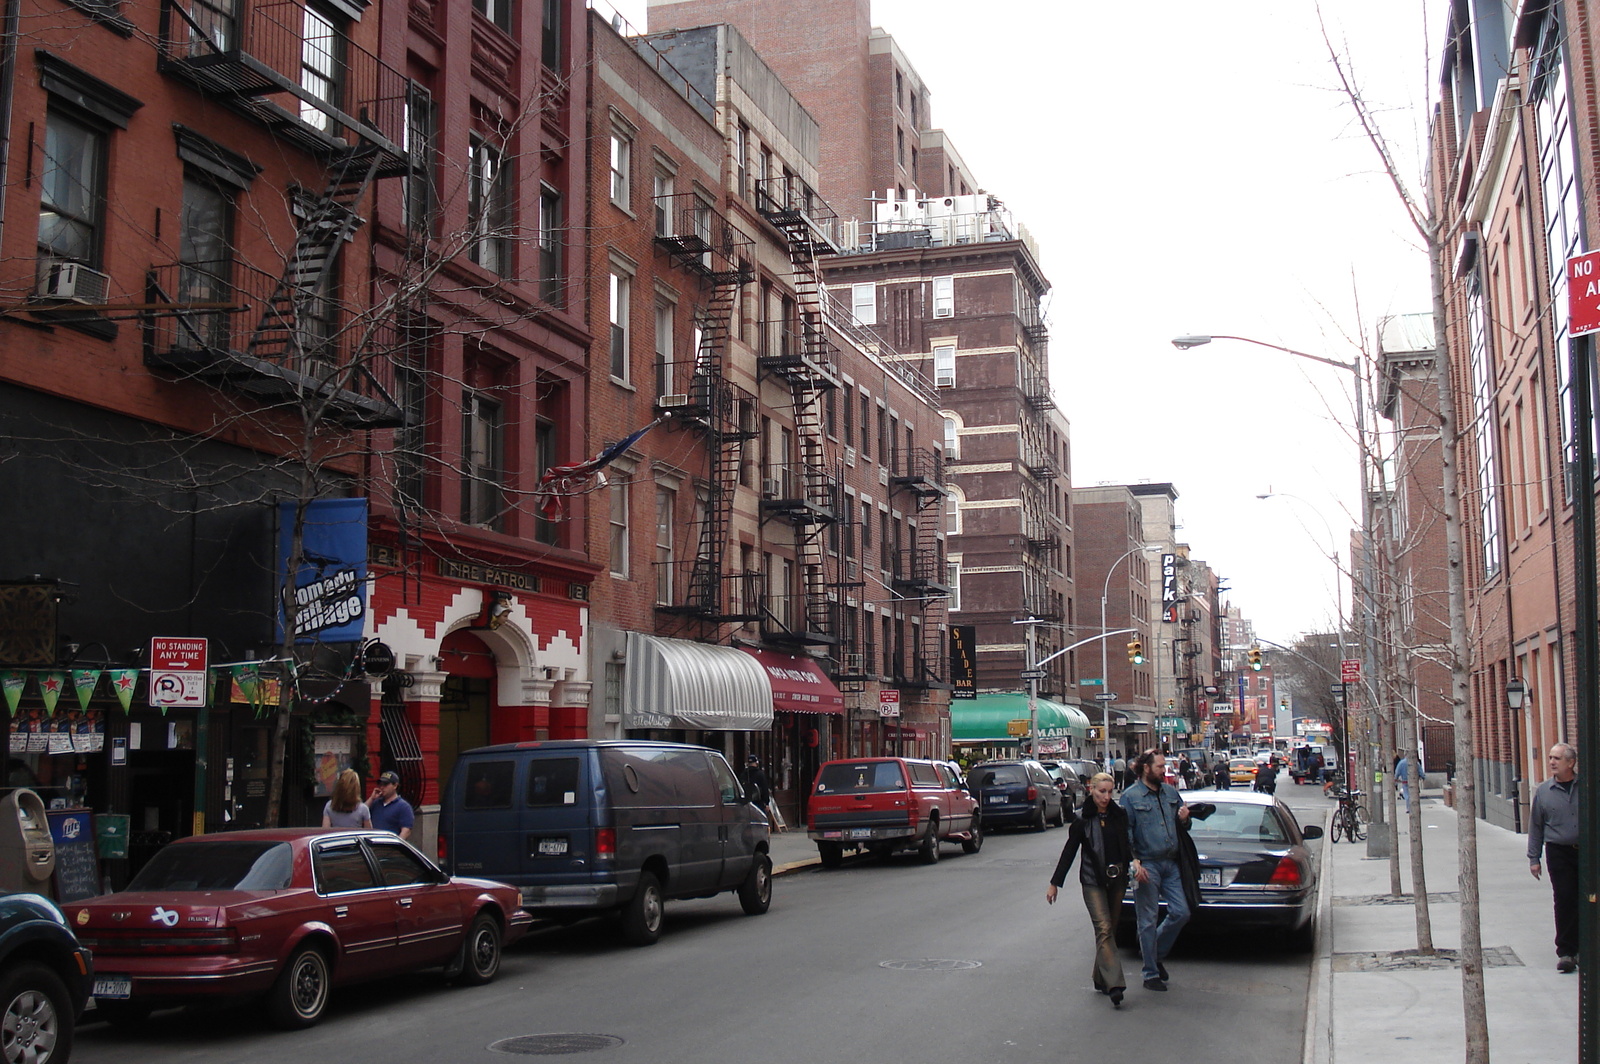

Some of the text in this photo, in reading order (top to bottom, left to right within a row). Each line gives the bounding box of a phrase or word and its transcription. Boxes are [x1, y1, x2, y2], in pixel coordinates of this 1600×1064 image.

[1574, 260, 1592, 278] NO
[1585, 279, 1600, 298] A
[378, 549, 388, 562] 2
[449, 562, 532, 589] FIRE PATROL
[1163, 555, 1175, 601] park
[576, 586, 583, 599] 2
[156, 642, 203, 651] NO STANDING
[953, 628, 972, 678] SHADE
[181, 652, 199, 660] TIME
[1214, 704, 1232, 712] park
